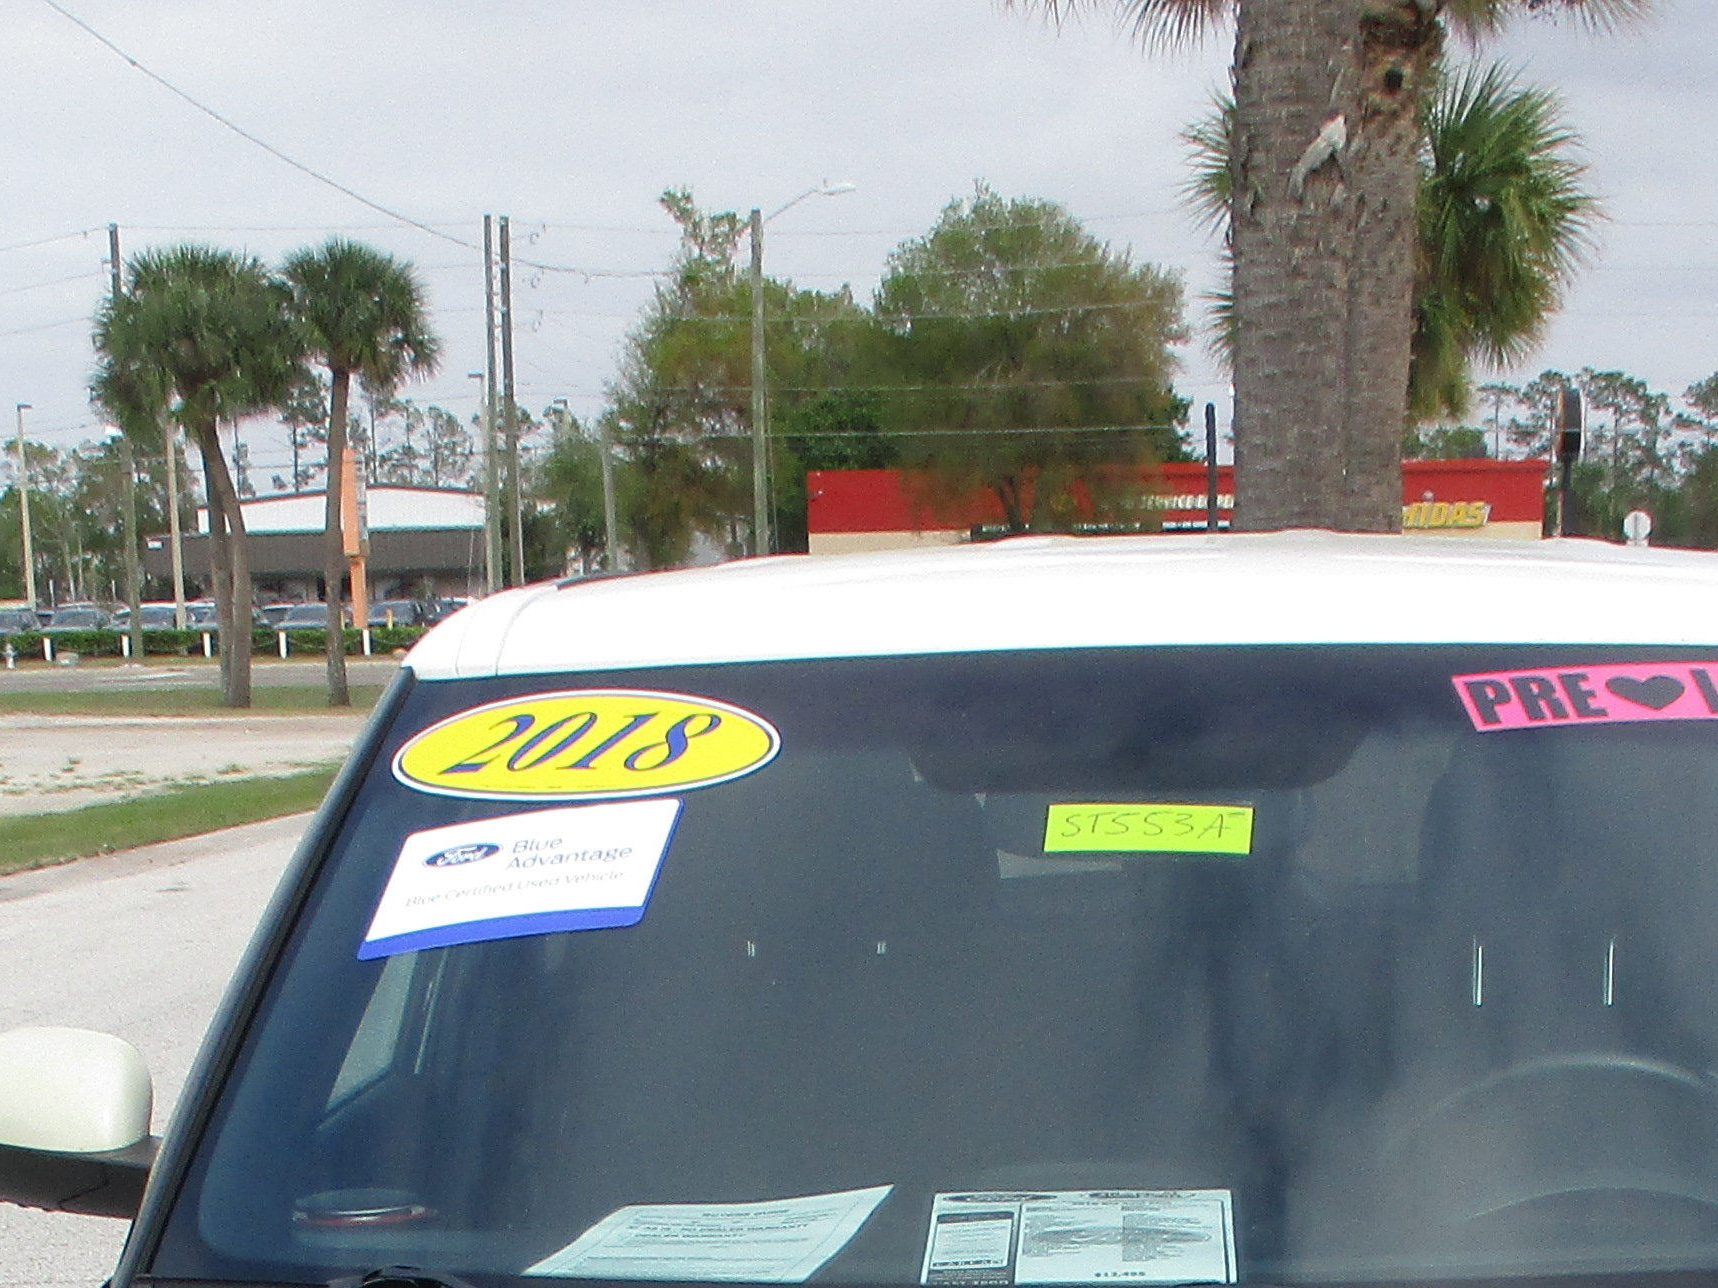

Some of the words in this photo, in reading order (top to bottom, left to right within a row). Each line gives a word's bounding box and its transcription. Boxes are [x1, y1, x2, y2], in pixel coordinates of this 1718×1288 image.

[1465, 673, 1609, 725] PRE
[439, 711, 723, 775] 2018
[505, 846, 633, 870] Advantage
[512, 838, 563, 854] Blue
